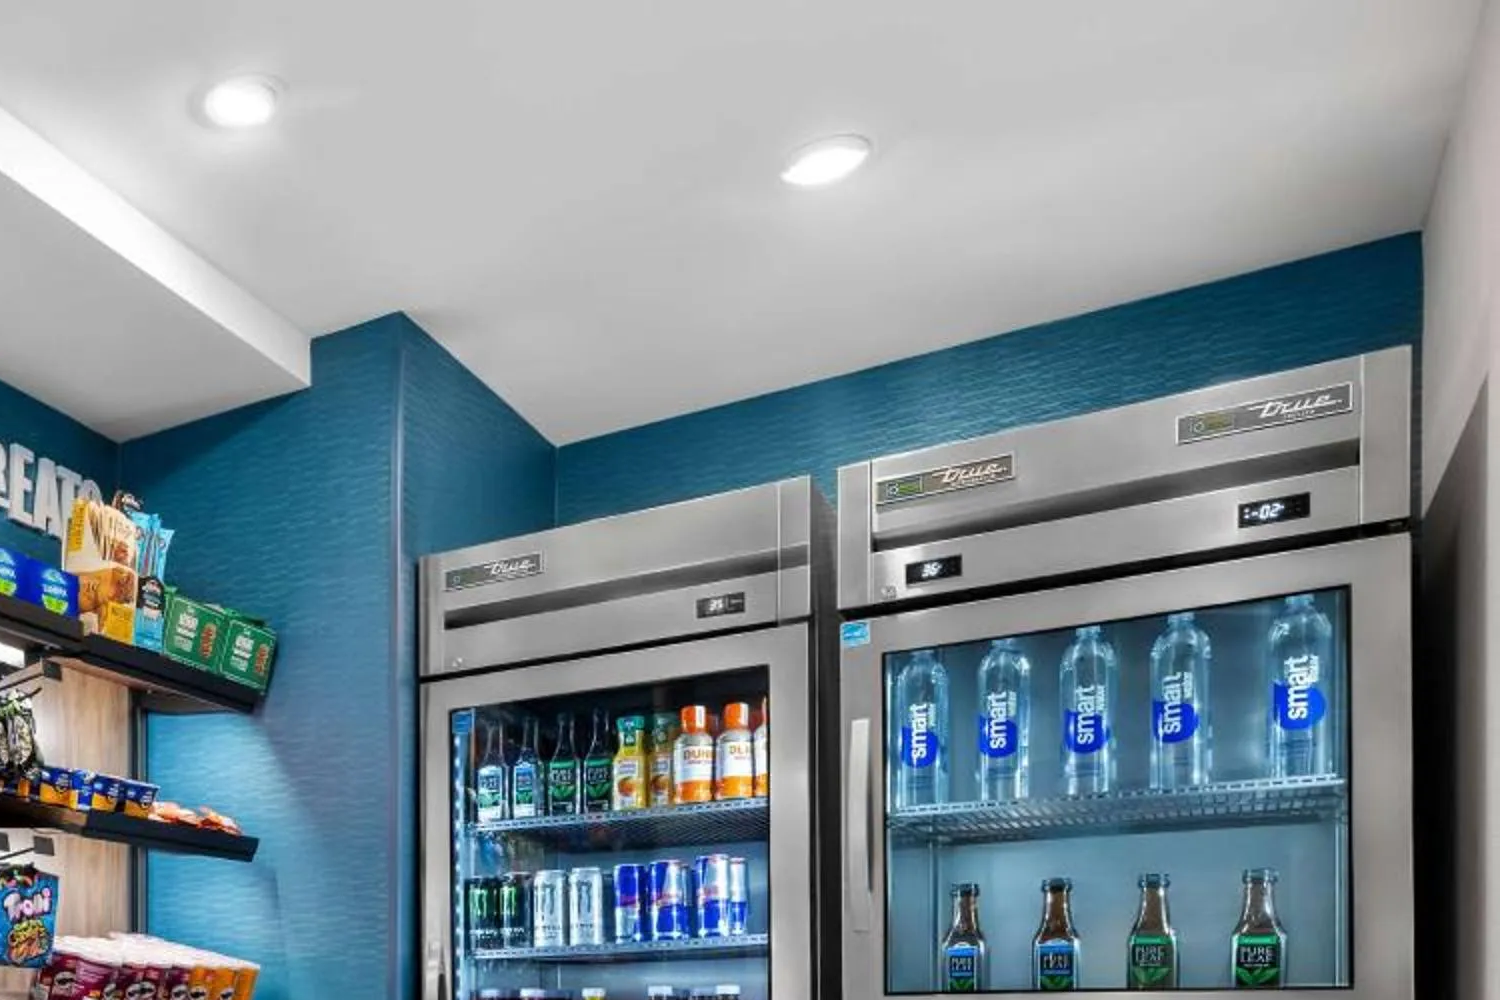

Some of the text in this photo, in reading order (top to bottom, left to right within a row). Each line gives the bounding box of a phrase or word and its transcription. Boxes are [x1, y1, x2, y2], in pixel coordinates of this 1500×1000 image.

[1075, 684, 1096, 745] smart
[1162, 671, 1183, 735] smart
[1283, 653, 1310, 721] smart
[910, 703, 928, 759] smart
[987, 691, 1008, 749] smart
